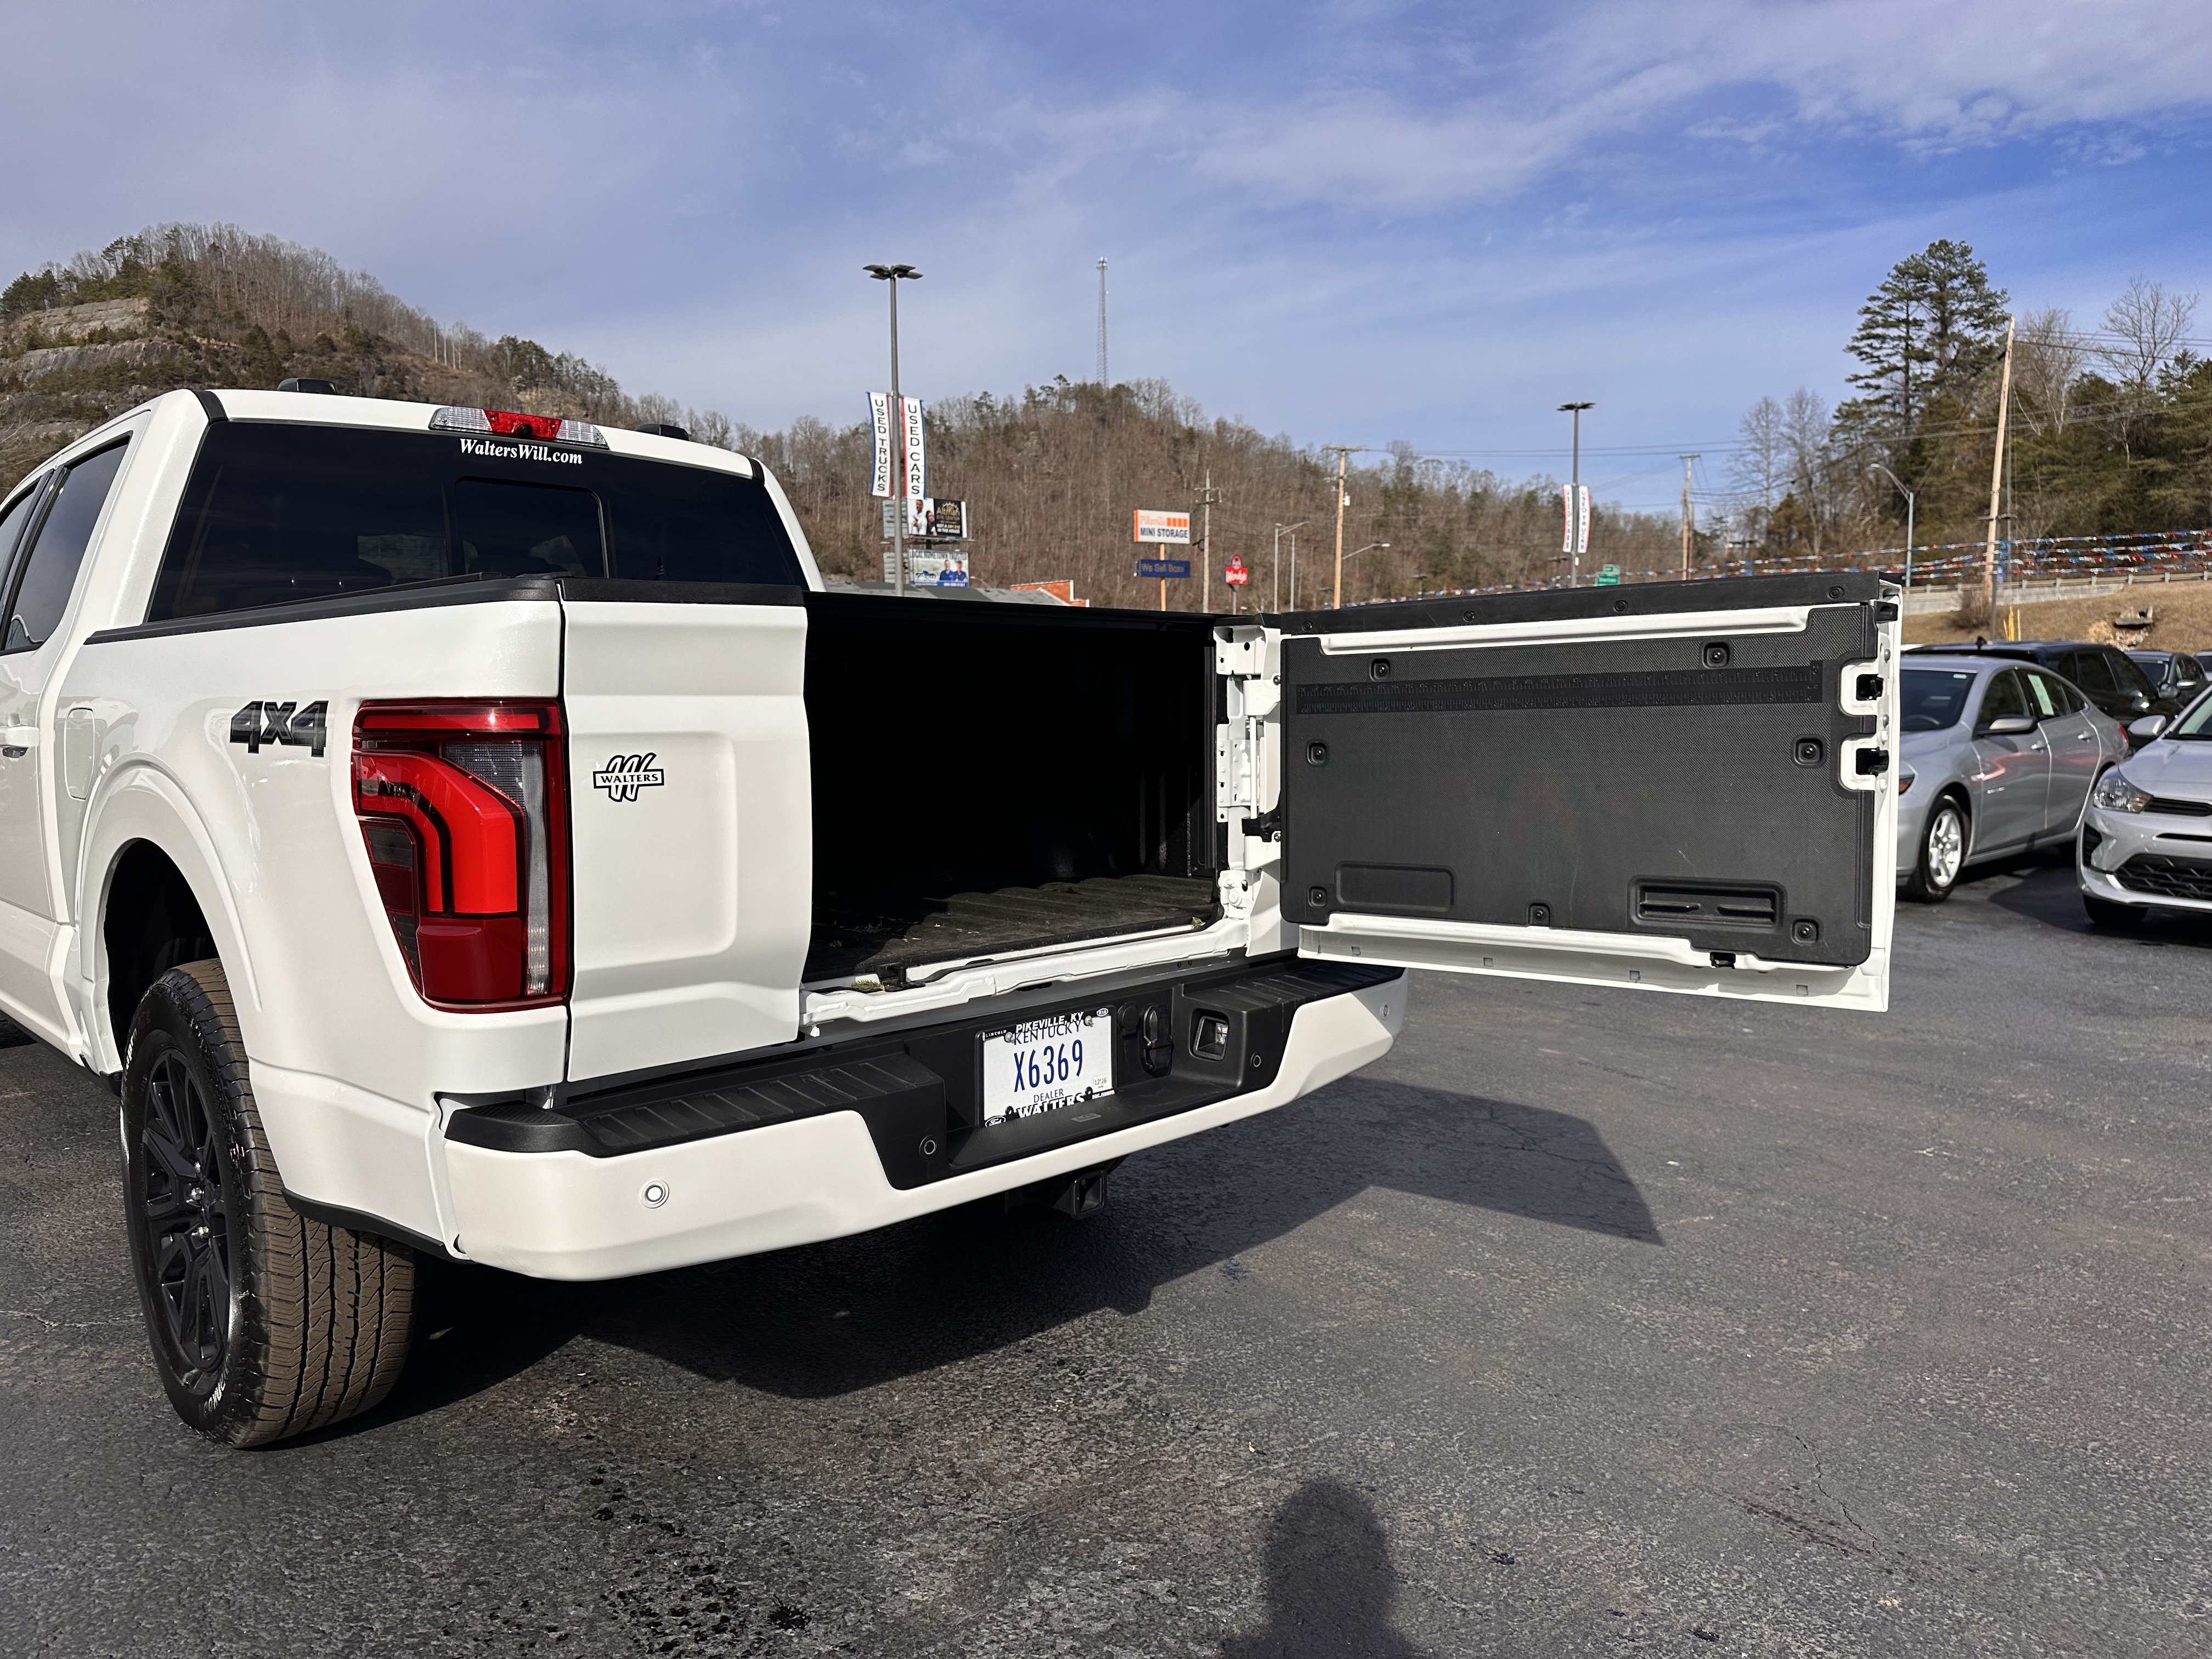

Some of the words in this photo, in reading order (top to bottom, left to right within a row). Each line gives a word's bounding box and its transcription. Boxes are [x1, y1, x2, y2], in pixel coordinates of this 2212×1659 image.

[875, 399, 887, 433] USED
[908, 404, 919, 446] USED
[460, 438, 583, 465] WaltersWill.com
[878, 438, 887, 492] TRUCKS
[910, 452, 920, 494] CARS
[1140, 527, 1155, 537] MINI
[1157, 528, 1188, 538] STORAGE
[600, 774, 658, 783] WALTERS
[1014, 1020, 1081, 1046] KENTUCKY
[1016, 1015, 1068, 1033] PIKEVILLE,
[1070, 1011, 1084, 1022] KY
[1014, 1039, 1083, 1093] X6369
[1034, 1088, 1064, 1103] DEALER
